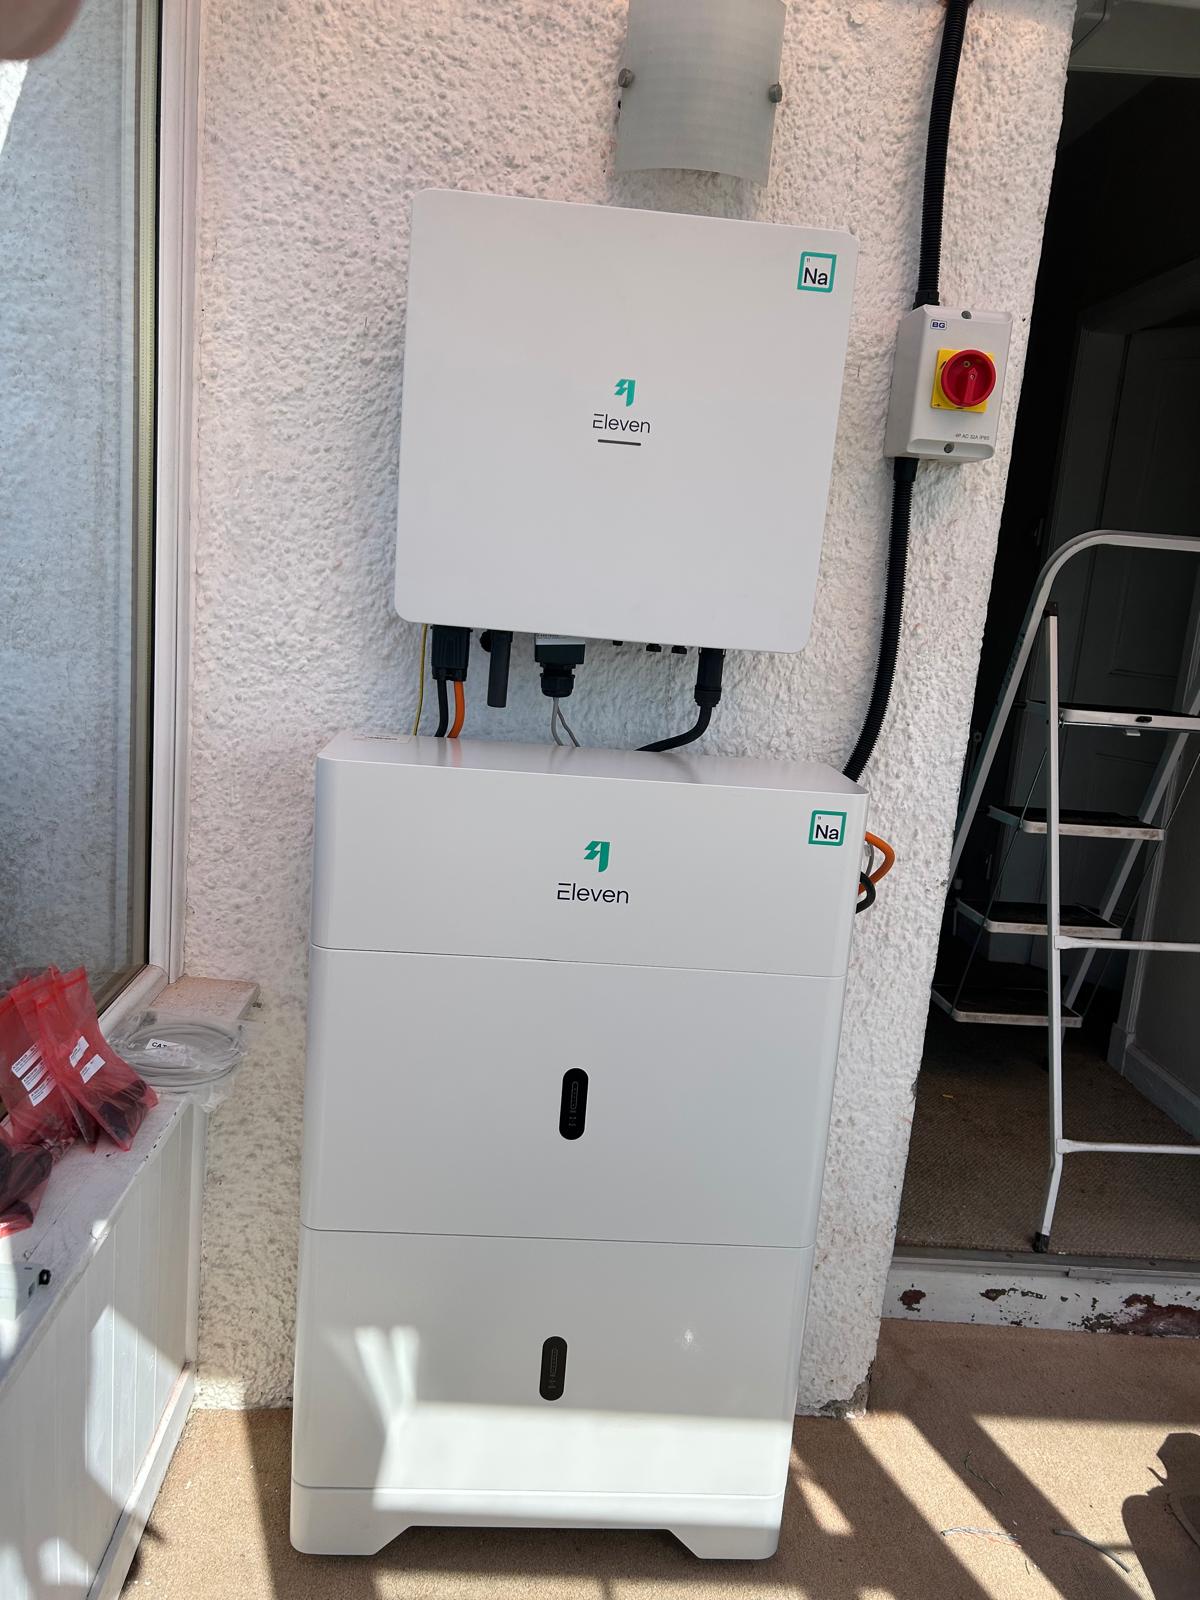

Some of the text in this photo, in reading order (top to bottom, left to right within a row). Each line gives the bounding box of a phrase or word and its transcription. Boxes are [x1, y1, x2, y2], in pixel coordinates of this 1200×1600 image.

[803, 267, 828, 285] Na
[932, 321, 946, 329] BG
[592, 413, 651, 434] Eleven
[815, 823, 839, 840] Na
[557, 883, 629, 904] Eleven
